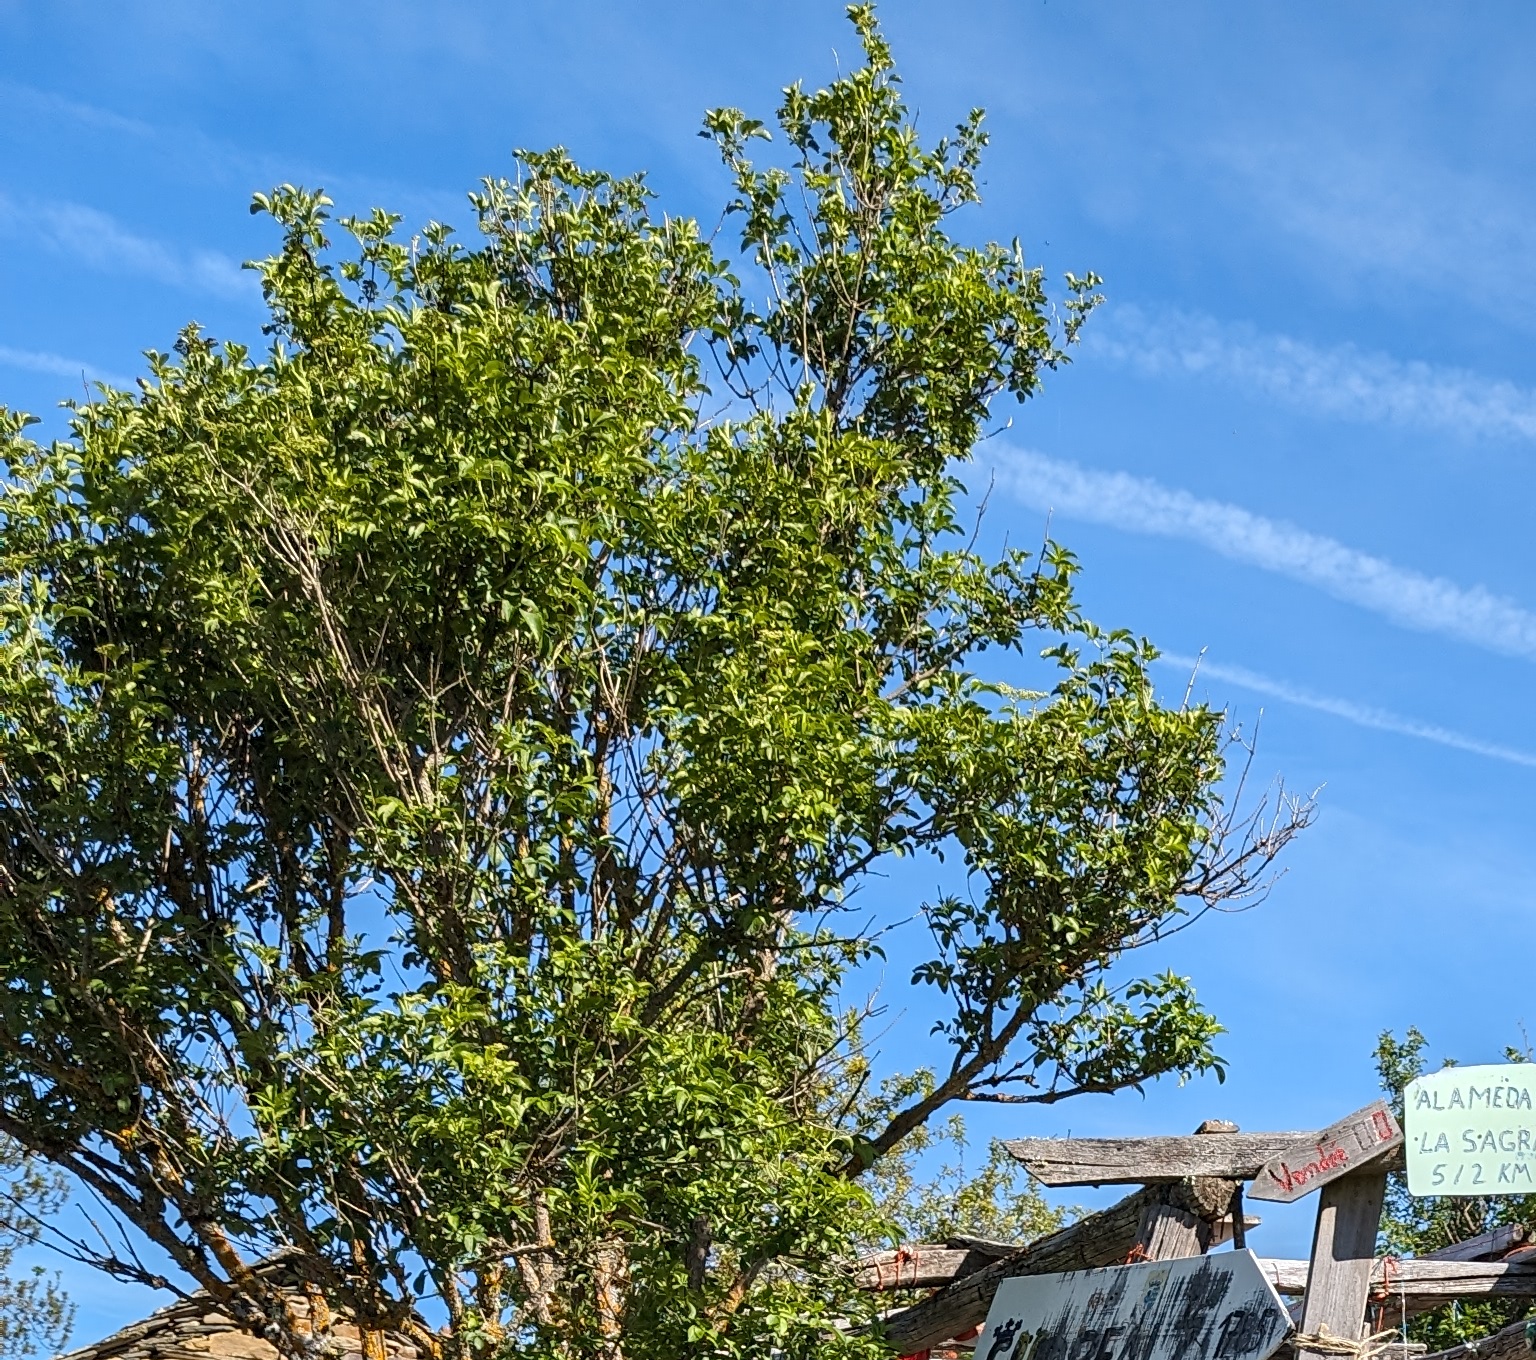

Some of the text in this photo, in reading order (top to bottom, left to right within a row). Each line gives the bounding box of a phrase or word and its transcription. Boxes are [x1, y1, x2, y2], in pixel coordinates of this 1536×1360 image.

[1416, 1085, 1533, 1111] ALAMEDA
[1419, 1131, 1450, 1154] LA
[1499, 1162, 1533, 1184] KM
